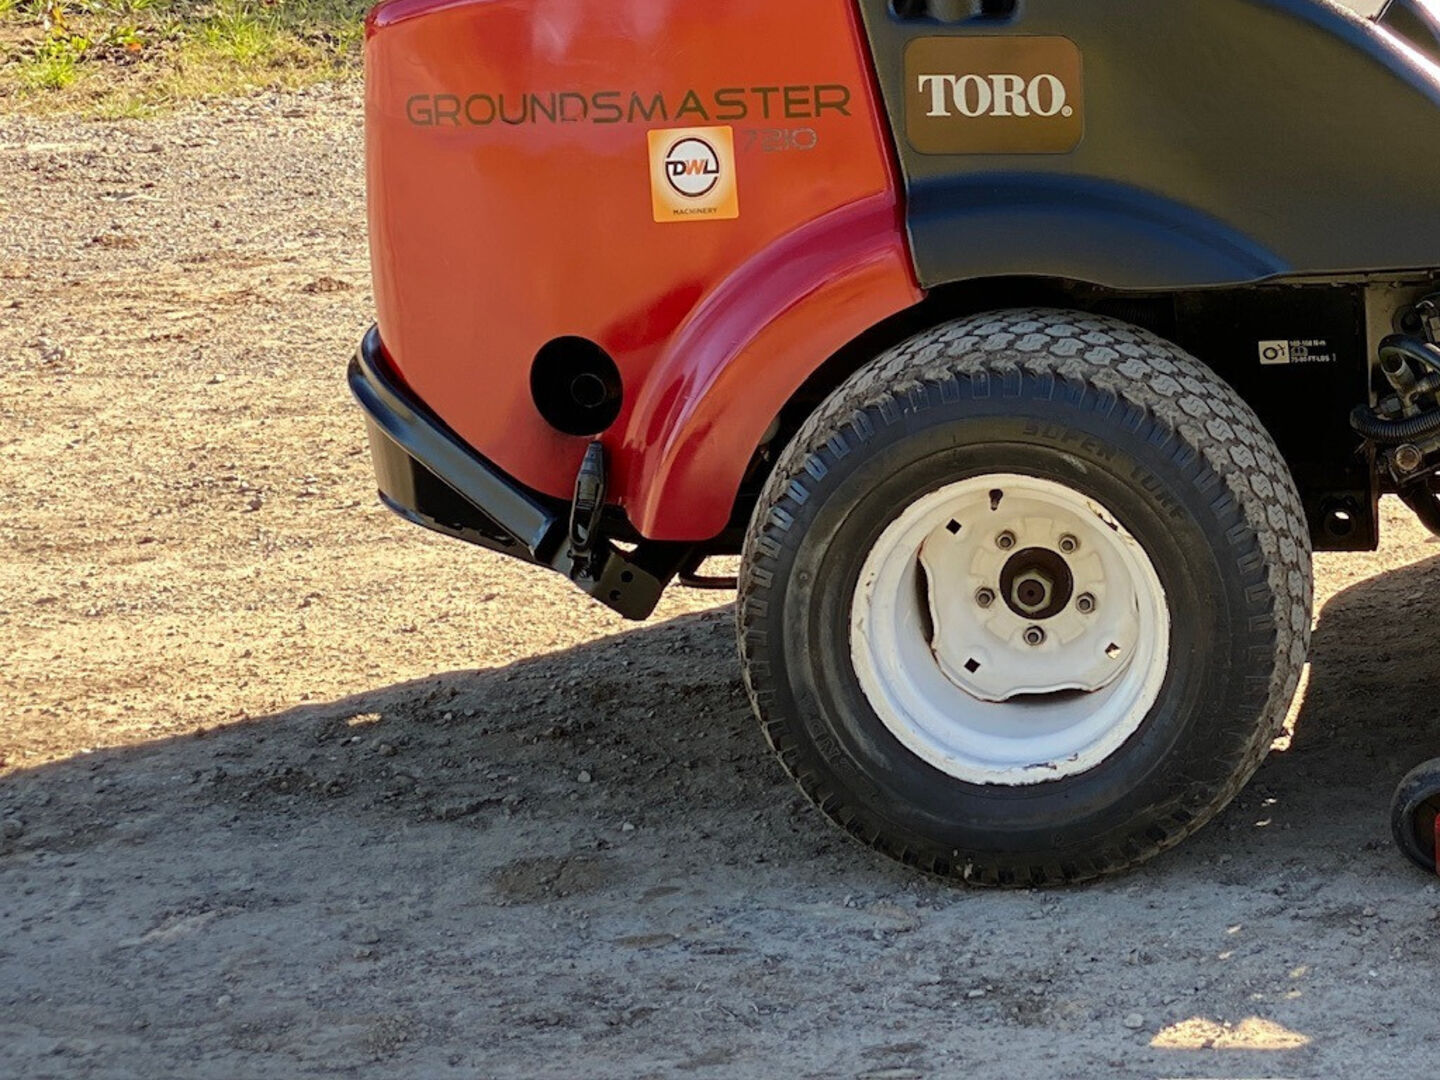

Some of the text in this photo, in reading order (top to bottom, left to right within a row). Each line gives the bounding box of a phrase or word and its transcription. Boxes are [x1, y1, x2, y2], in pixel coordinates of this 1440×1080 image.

[406, 84, 852, 126] GROUNDSMASTER
[742, 127, 818, 153] 7210
[666, 158, 719, 177] DWL
[673, 206, 717, 216] MACHINERY
